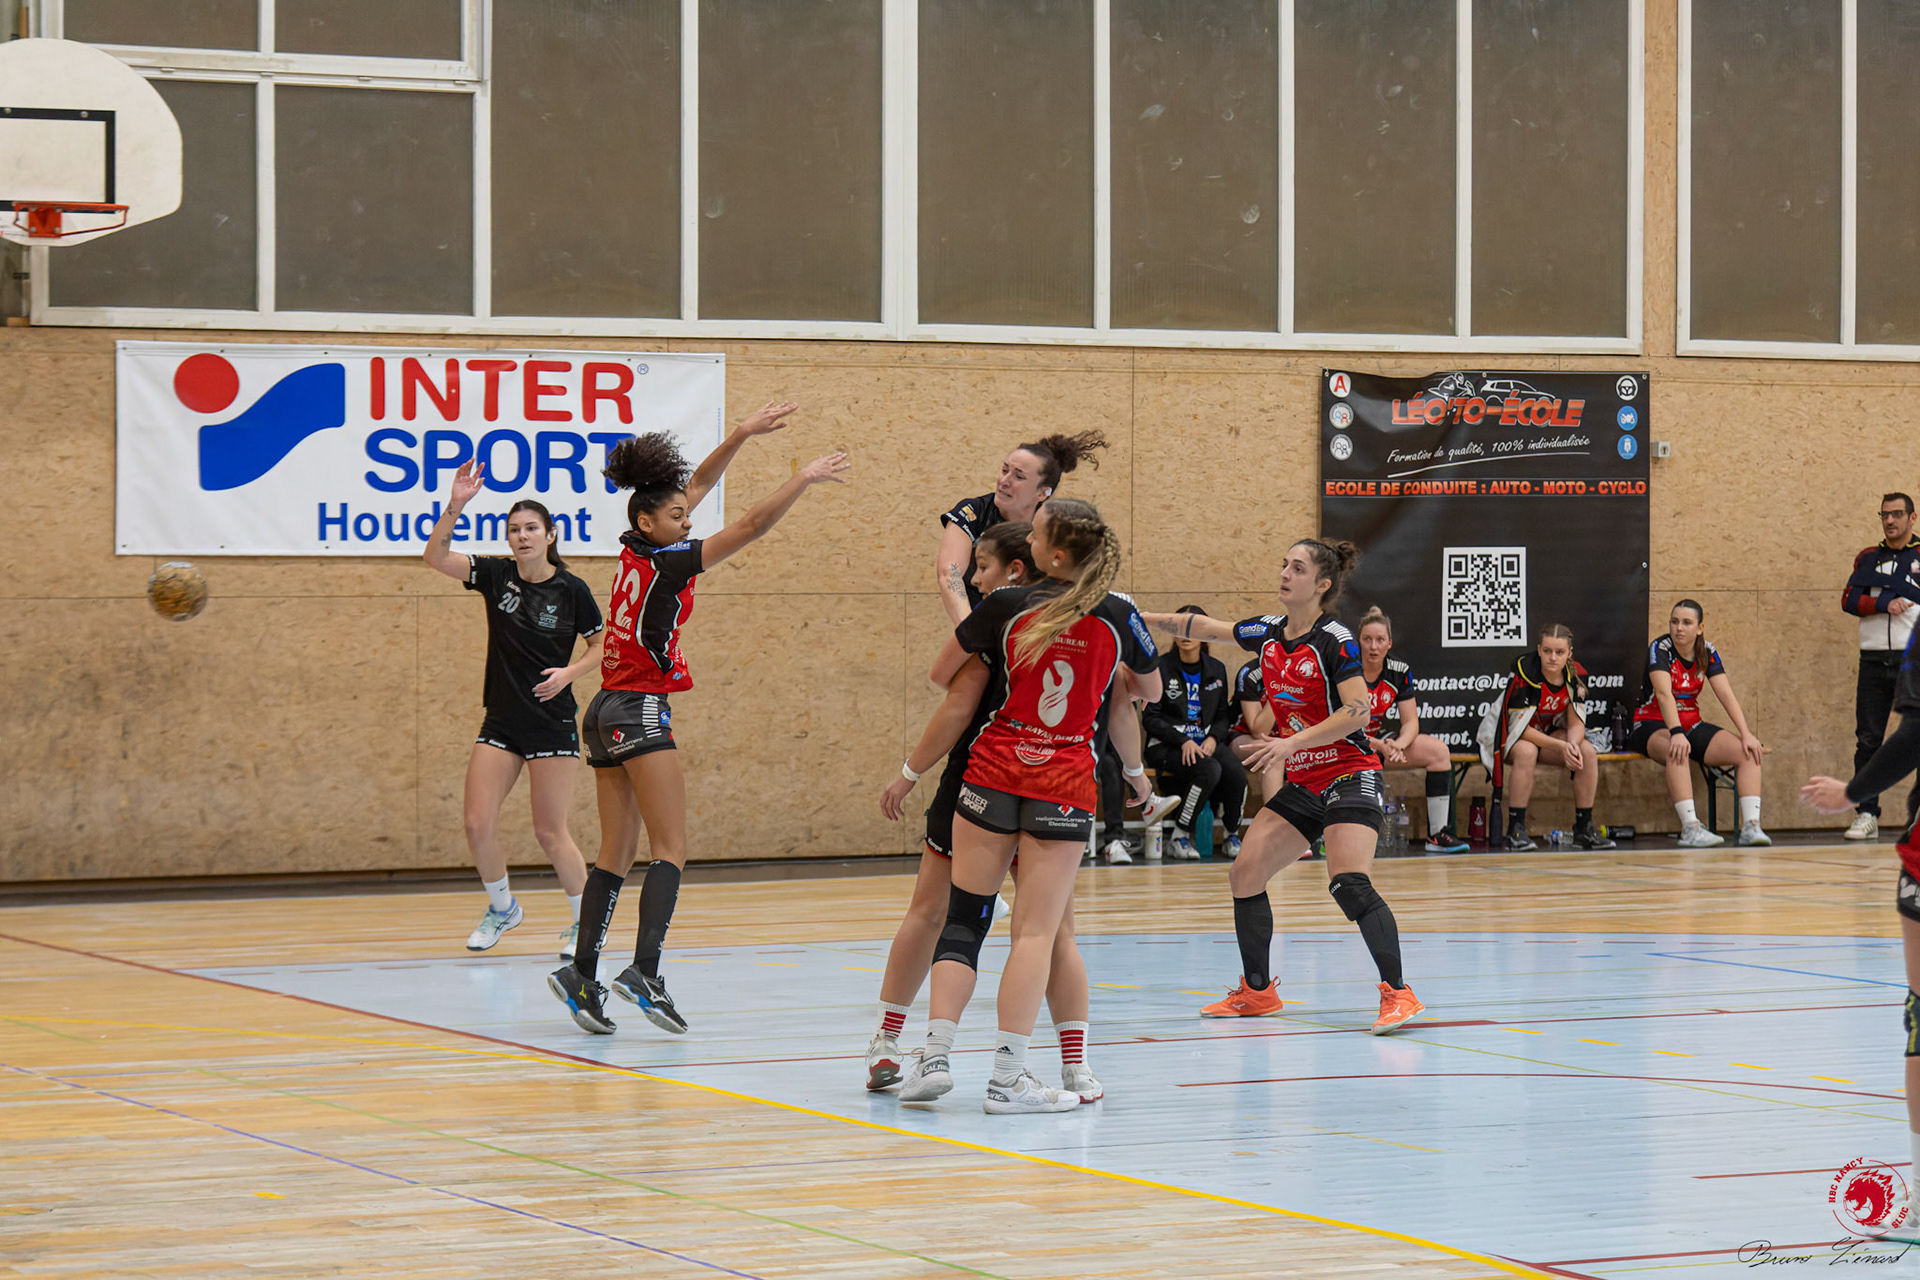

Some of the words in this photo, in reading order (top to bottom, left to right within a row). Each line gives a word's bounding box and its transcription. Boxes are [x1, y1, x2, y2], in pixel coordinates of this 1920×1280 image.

[370, 357, 634, 424] INTER
[365, 428, 636, 494] SPORT
[1387, 448, 1431, 463] Formation
[1434, 446, 1444, 458] de
[1492, 440, 1524, 453] 100%
[1527, 434, 1590, 451] individualisée
[1325, 481, 1376, 496] ECOLE
[1380, 481, 1400, 496] DE
[1403, 480, 1477, 495] CONDUITE
[1489, 481, 1531, 495] AUTO
[1543, 481, 1586, 495] MOTO
[1598, 481, 1647, 495] CYCLO
[318, 501, 592, 542] Houdemnt
[498, 592, 520, 613] 20
[1037, 659, 1074, 728] 8
[1412, 673, 1509, 692] contact@le
[1542, 696, 1560, 710] 26
[1286, 748, 1338, 765] MPTOIR
